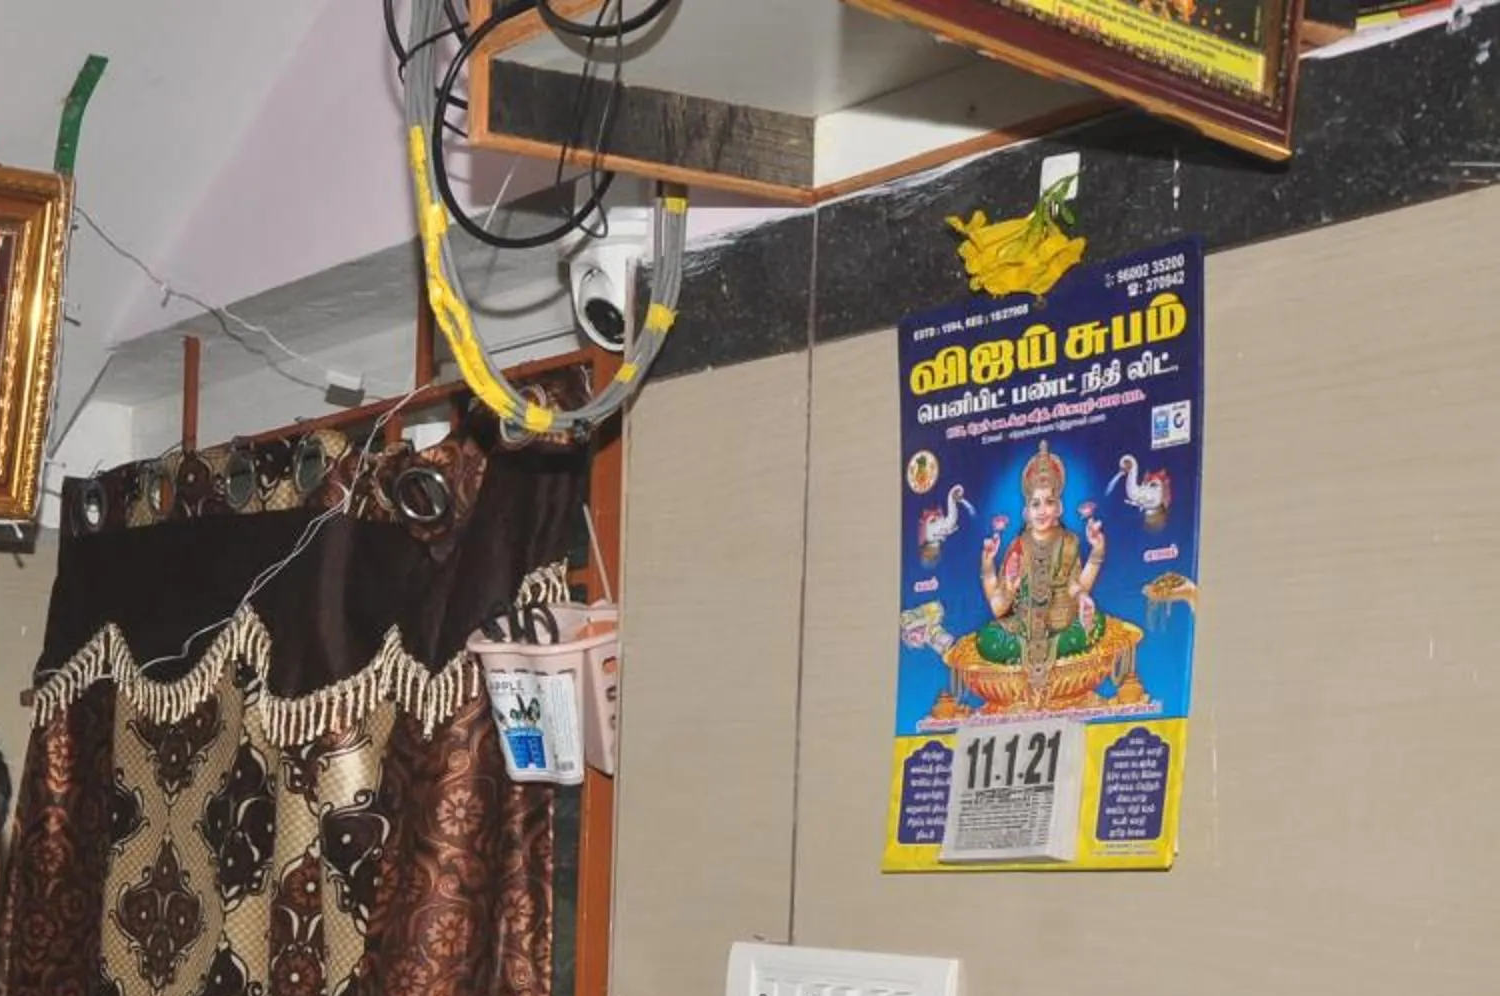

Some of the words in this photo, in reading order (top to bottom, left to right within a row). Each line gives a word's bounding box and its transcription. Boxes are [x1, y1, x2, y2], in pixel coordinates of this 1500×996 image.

[910, 323, 1057, 395] விஜய்
[1064, 292, 1188, 360] சுபம்
[917, 387, 1007, 424] பெனிபிட்
[1080, 358, 1121, 396] நிதி
[967, 730, 1062, 789] 11.1.21
